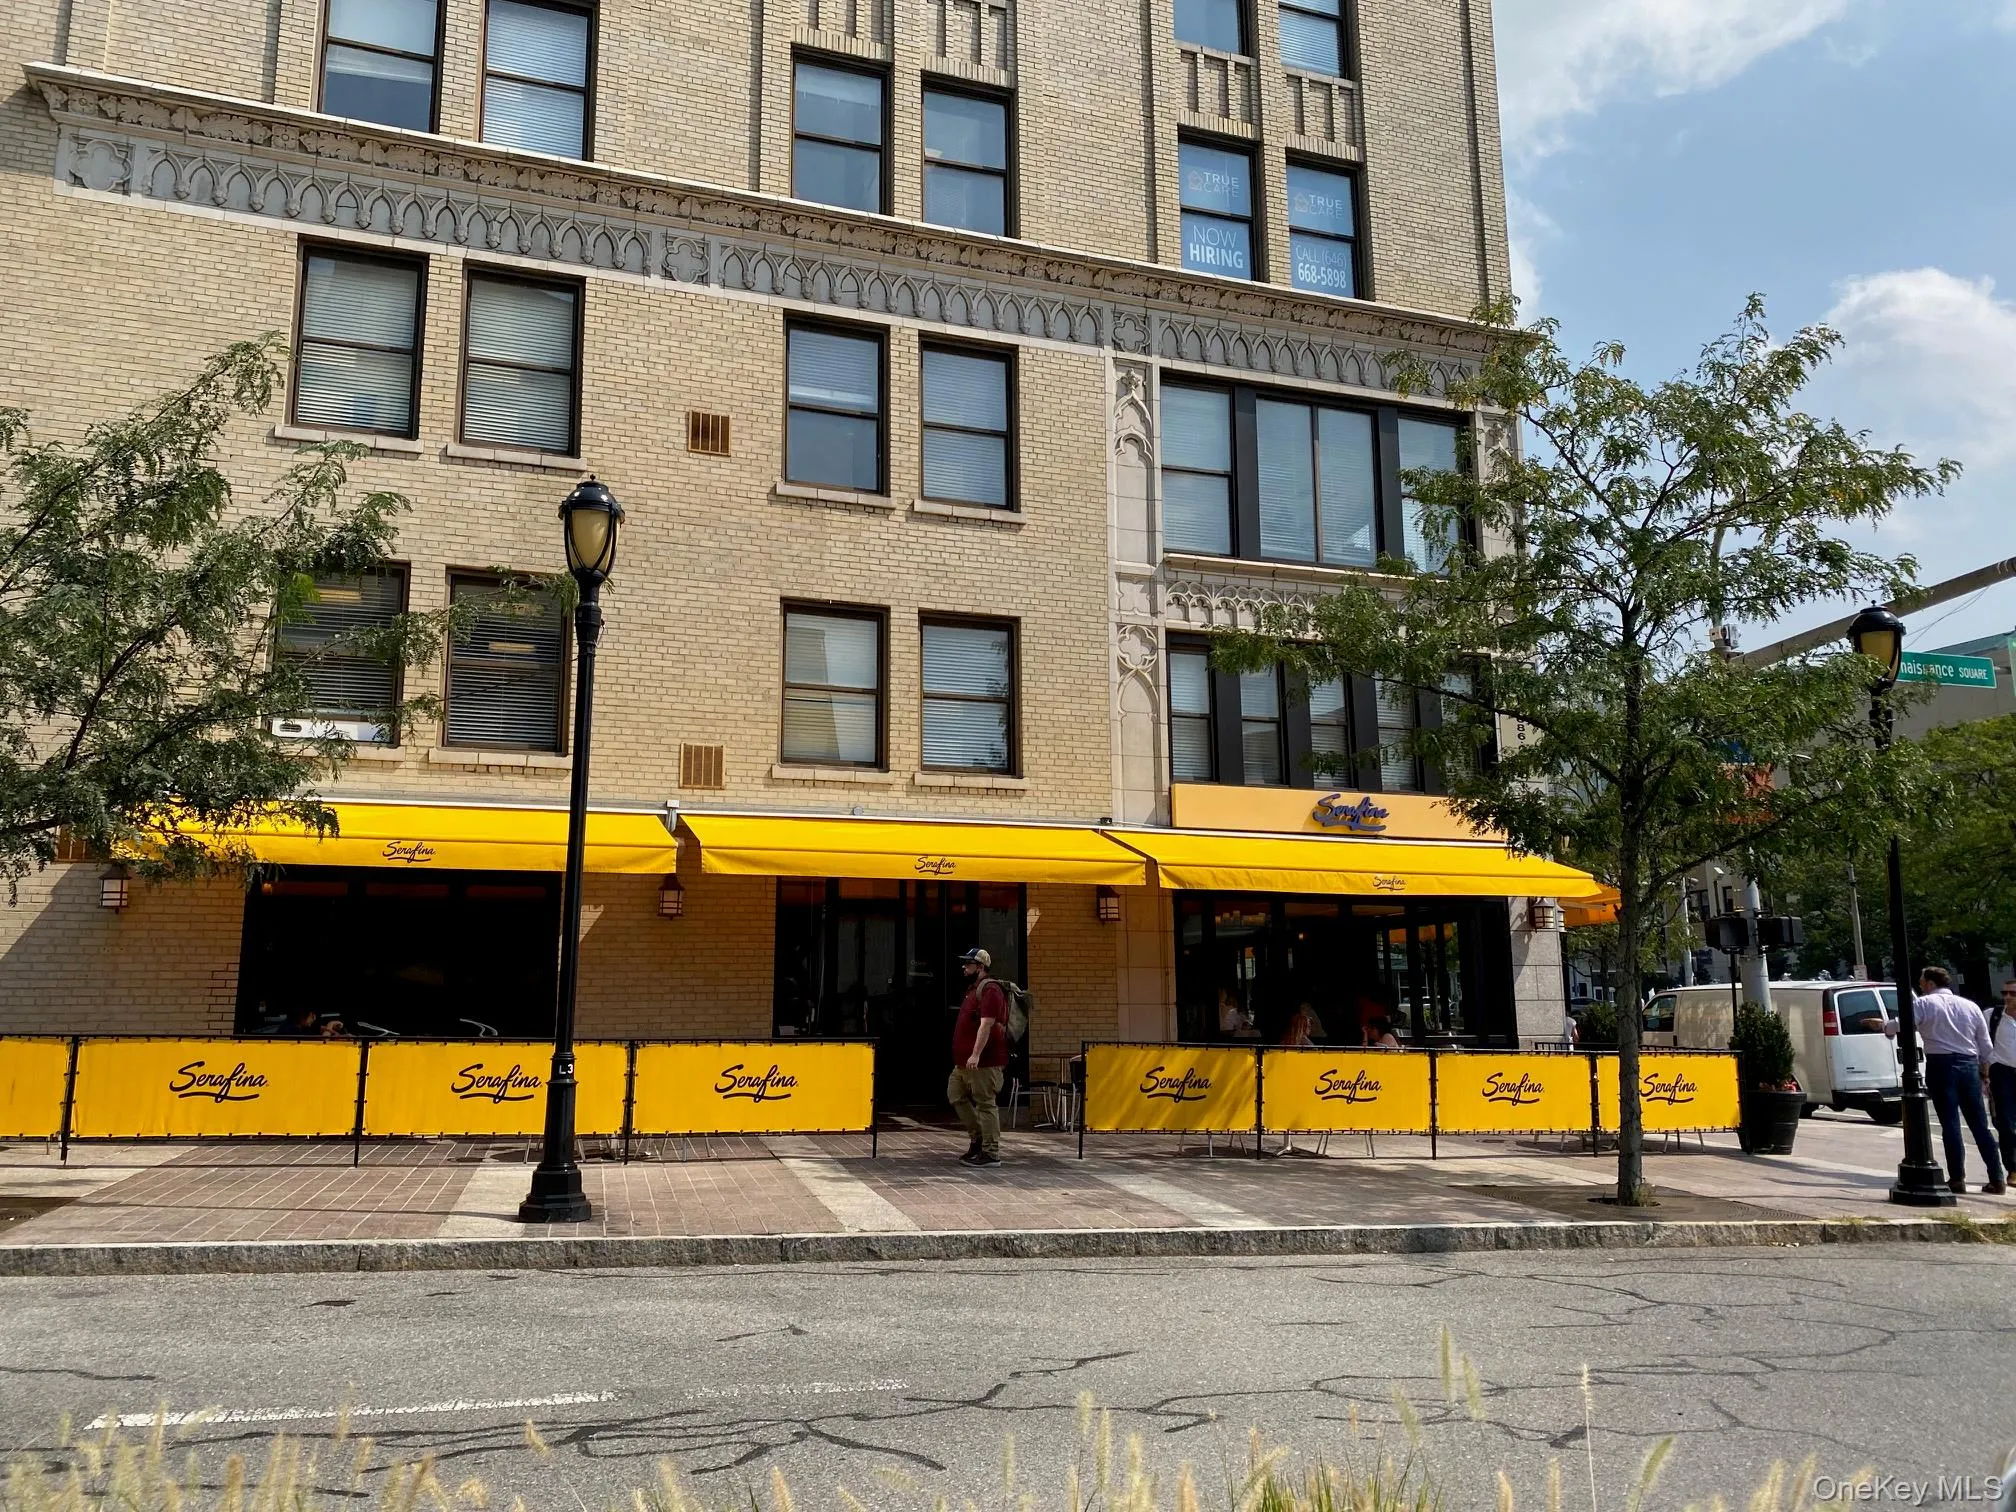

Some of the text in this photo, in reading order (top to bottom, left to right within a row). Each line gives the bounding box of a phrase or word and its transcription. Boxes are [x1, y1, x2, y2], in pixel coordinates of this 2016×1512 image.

[1203, 172, 1239, 188] TRUE
[1204, 182, 1239, 198] CARE
[1309, 194, 1343, 209] TRUE
[1309, 205, 1344, 219] CARE
[1193, 225, 1237, 248] NOW
[1189, 243, 1243, 269] HIRING
[1296, 245, 1321, 264] CALL
[1298, 263, 1347, 289] 668-5898
[1959, 667, 1988, 680] SQUARE
[1313, 793, 1390, 831] Serafina
[382, 841, 435, 863] Serafina
[914, 856, 956, 875] Serafina
[1373, 875, 1406, 891] Serafina
[559, 1063, 574, 1075] L3
[169, 1061, 268, 1104] Serafina
[451, 1063, 542, 1104] Serafina
[714, 1064, 797, 1104] Serafina
[1139, 1066, 1212, 1104] Serafina
[1314, 1069, 1382, 1105] Serafina
[1482, 1072, 1544, 1106] Serafina
[1640, 1073, 1697, 1105] Serafina
